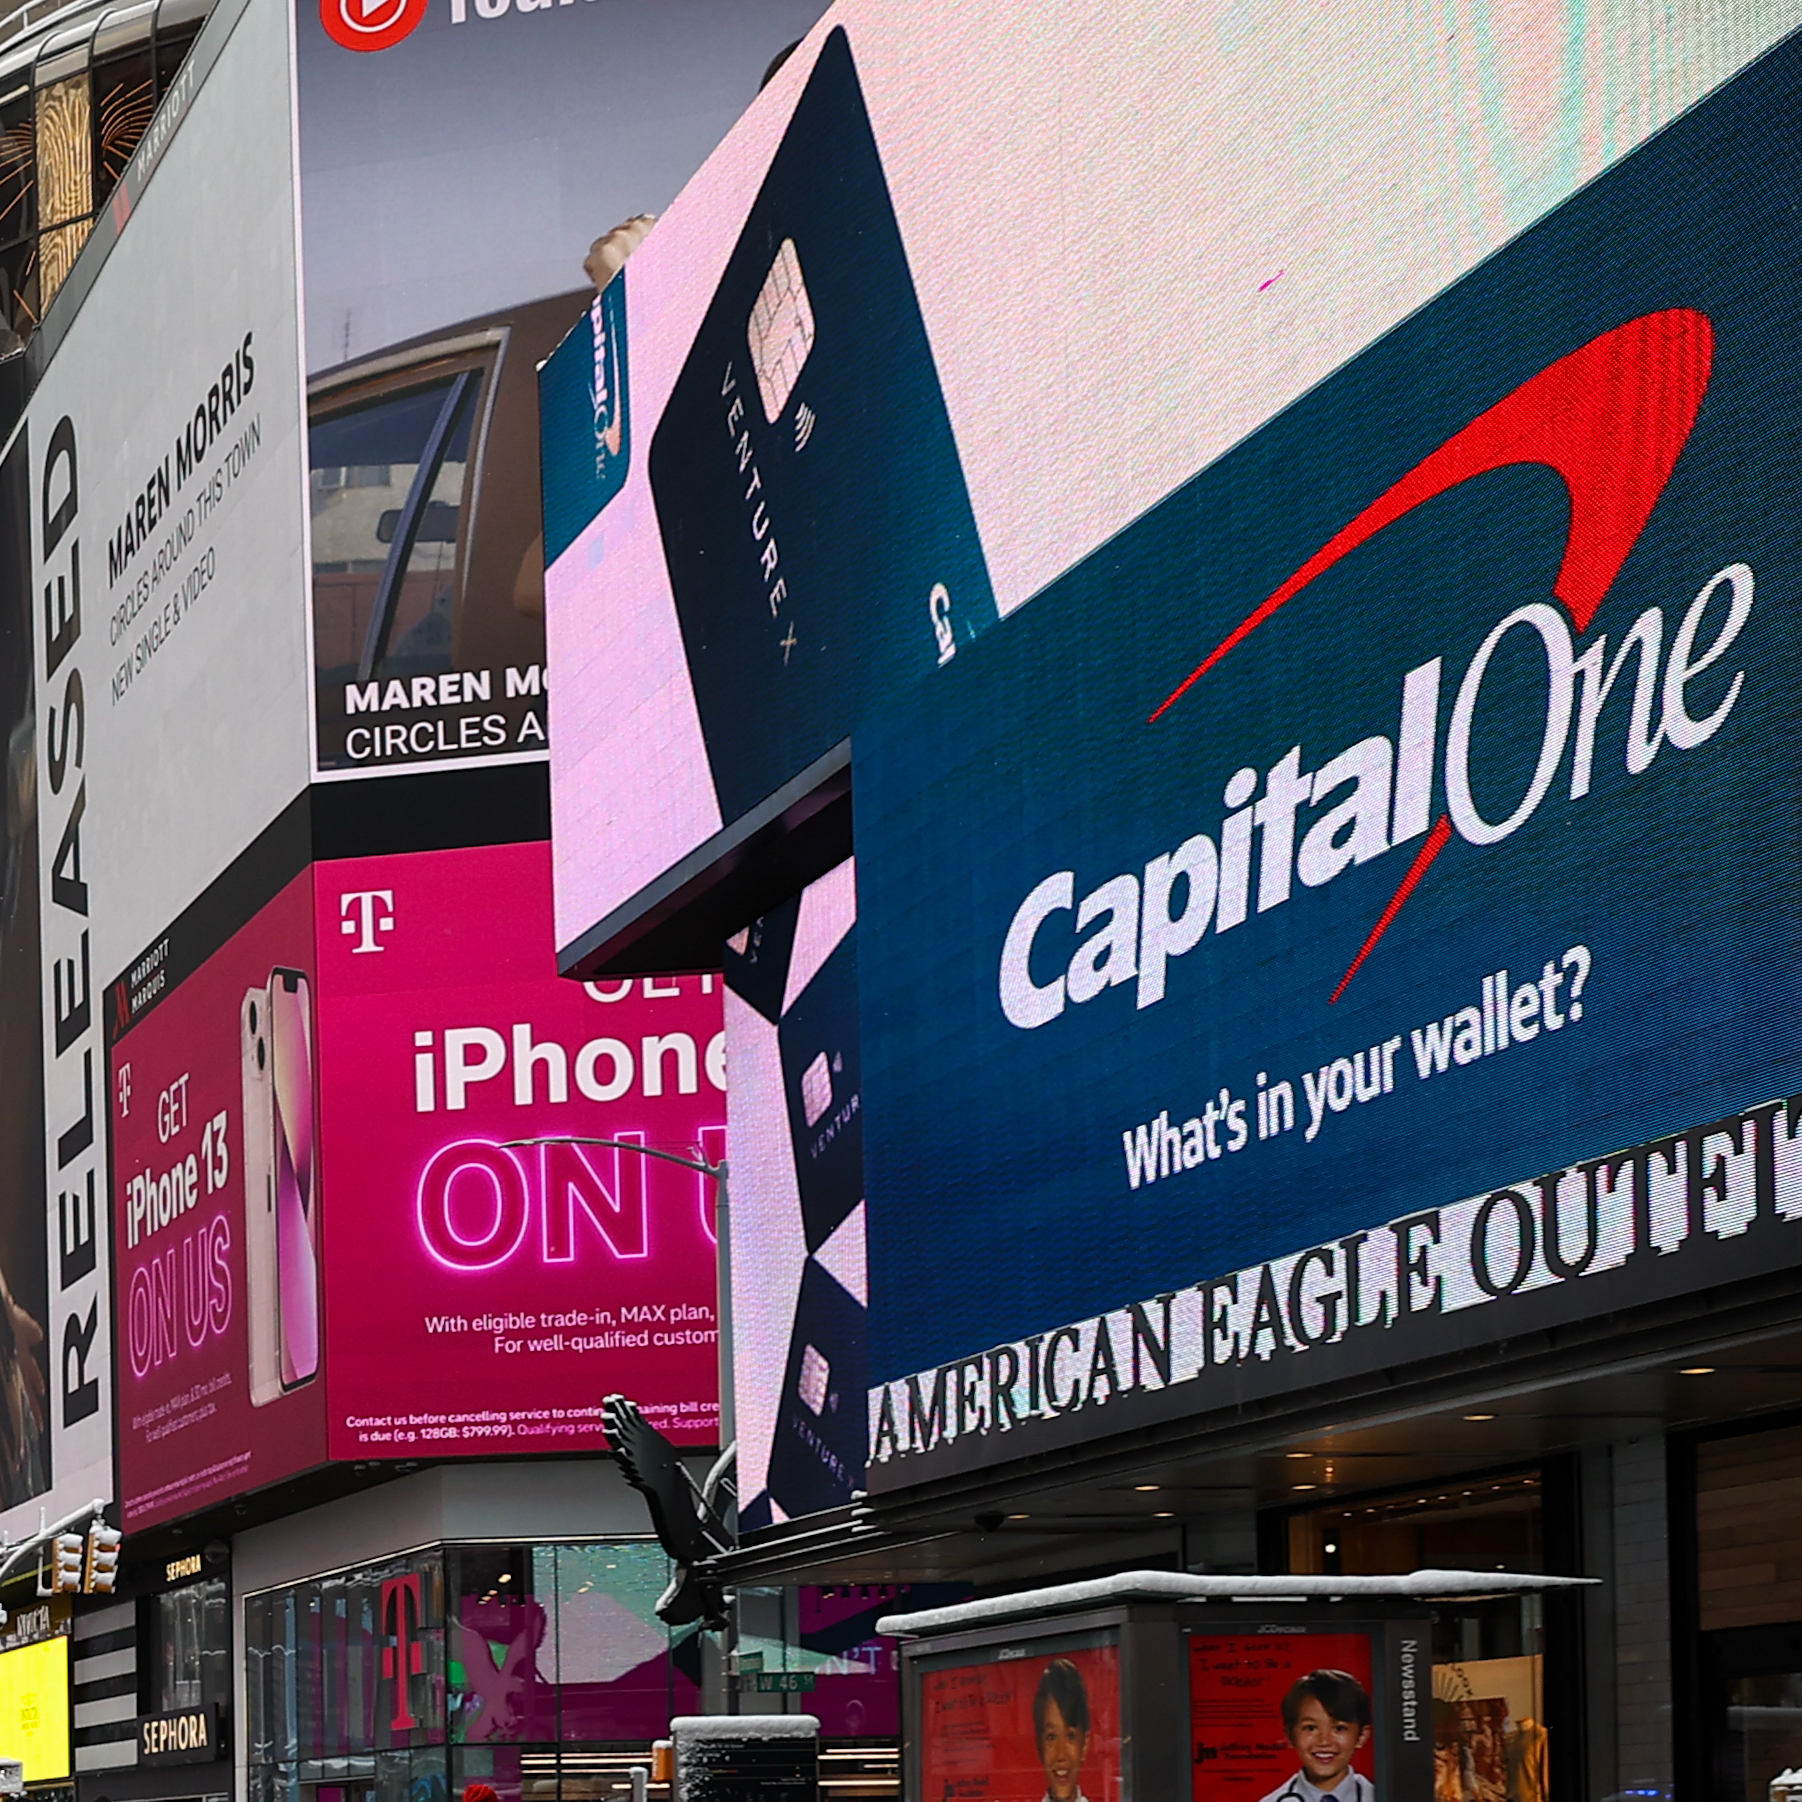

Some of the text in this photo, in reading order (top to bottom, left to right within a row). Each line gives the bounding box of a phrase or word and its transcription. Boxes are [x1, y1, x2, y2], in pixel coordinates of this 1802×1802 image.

[108, 330, 255, 590] MAREN MORRIS
[109, 413, 261, 647] CIRCLES AROUND THIS TOWN
[717, 358, 799, 667] VENTURE X
[111, 546, 216, 706] NEW SINGLE & VIDEO
[346, 665, 491, 715] MAREN
[346, 714, 507, 759] CIRCLES
[43, 414, 101, 1432] RELEASED
[131, 938, 170, 988] MARRIOTT
[131, 969, 166, 1014] MARQUIS
[1123, 944, 1594, 1190] What's in your wallet?
[156, 1072, 191, 1146] GET
[125, 1110, 230, 1251] iPhone 13
[417, 1130, 649, 1273] ON
[127, 1212, 234, 1380] ON US
[425, 1303, 715, 1335] With eligible trade-in, MAX plan,
[494, 1330, 649, 1354] For well-qualified
[871, 1208, 1442, 1466] AMERICAN EAGLE
[346, 1400, 698, 1428] Contact us before cancelling service to bill
[359, 1430, 368, 1441] is
[370, 1428, 393, 1441] due
[517, 1421, 575, 1438] Qualifying
[166, 1554, 202, 1582] SEPHORA
[761, 1675, 798, 1690] W 46
[1400, 1639, 1420, 1742] Newsstand
[144, 1713, 208, 1756] SEPHORA
